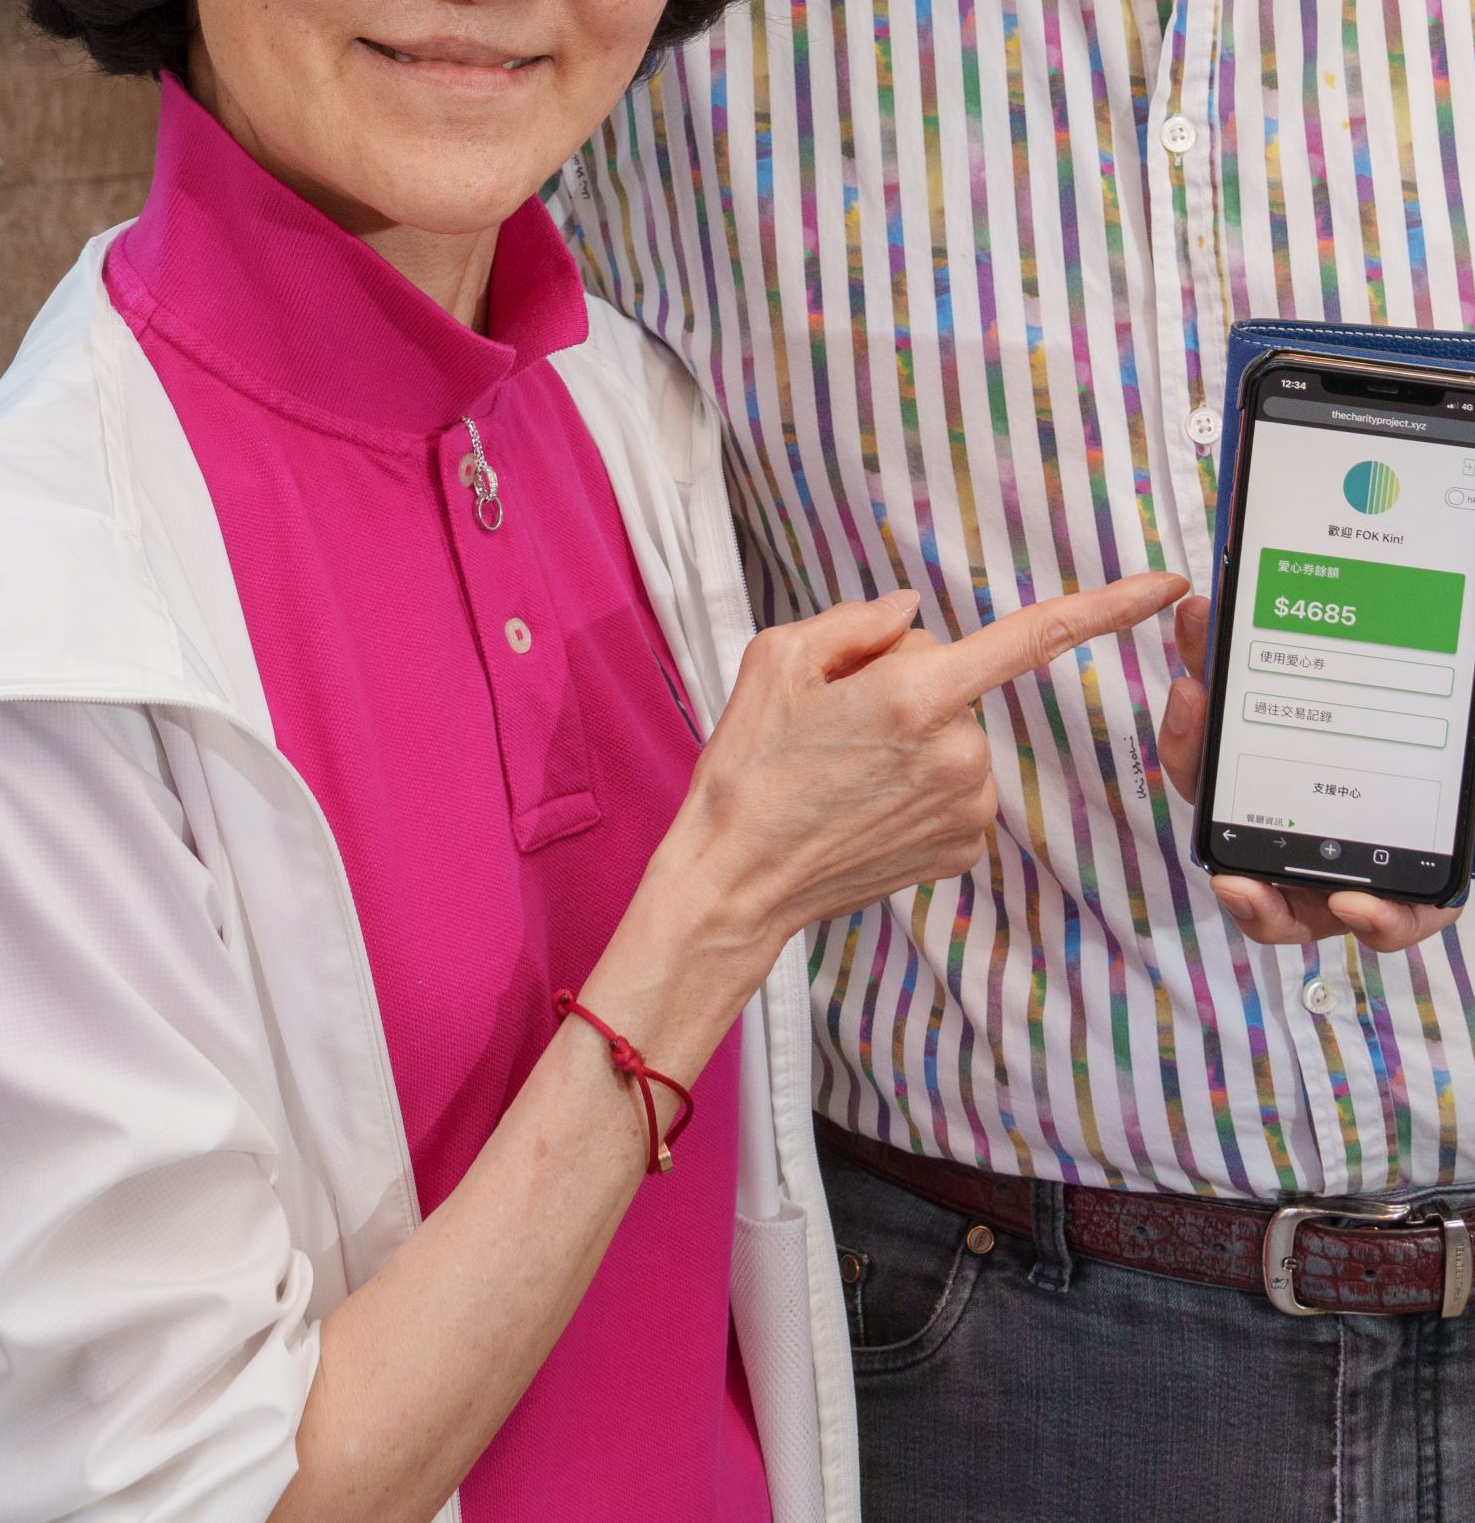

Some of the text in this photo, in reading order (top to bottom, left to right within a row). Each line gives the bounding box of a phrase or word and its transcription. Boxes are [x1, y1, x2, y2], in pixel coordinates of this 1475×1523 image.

[1280, 378, 1474, 412] 12:34 4G
[1331, 409, 1428, 432] thecharityproject.xyz
[1327, 524, 1405, 546] 歡迎 FOK Kin!
[1277, 559, 1341, 580] 愛心券餘額
[1273, 595, 1358, 627] $4685
[1259, 649, 1326, 671] 使用愛心券
[1253, 701, 1334, 724] 過往交易記錄
[1311, 781, 1362, 800] 支援中心
